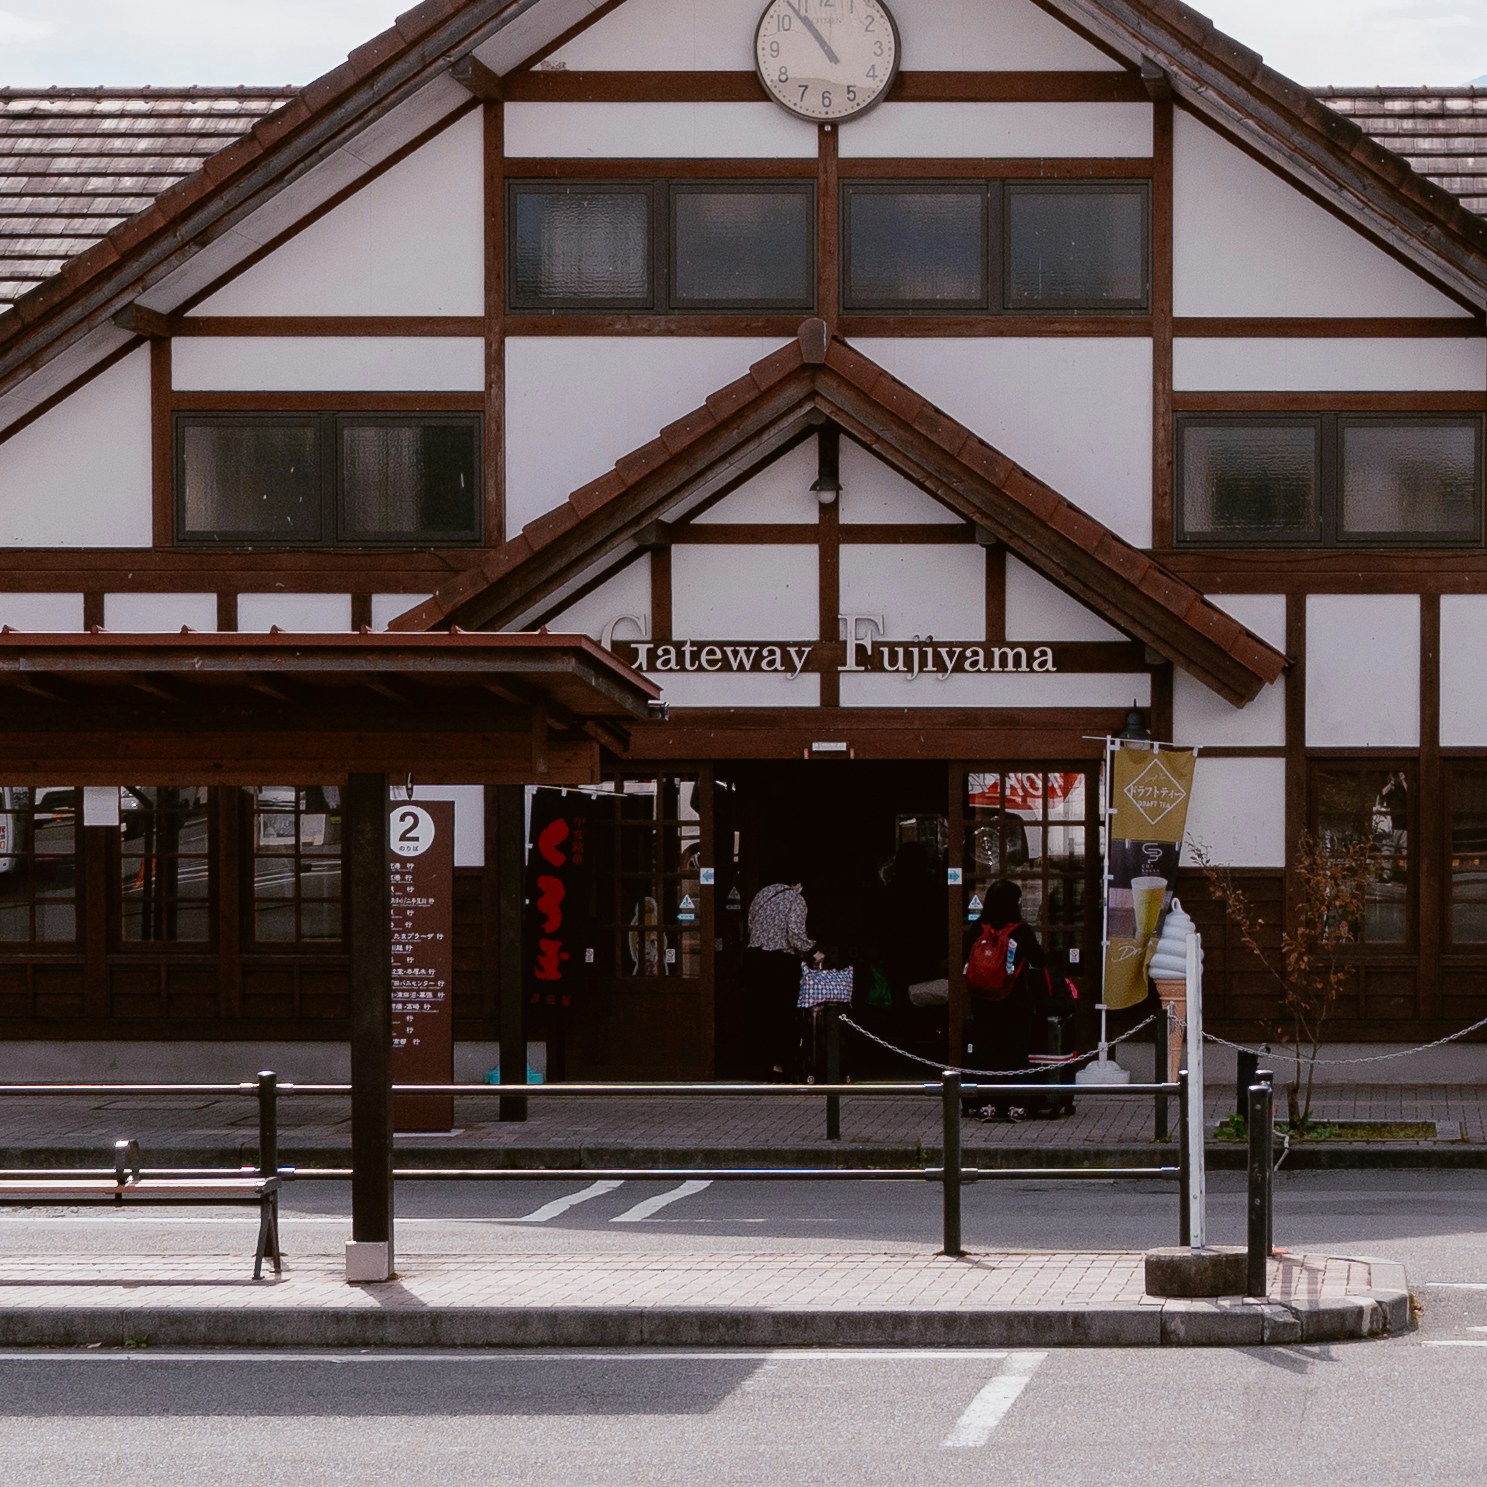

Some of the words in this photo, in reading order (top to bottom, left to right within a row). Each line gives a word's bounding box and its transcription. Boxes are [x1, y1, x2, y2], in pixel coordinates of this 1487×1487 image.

[777, 14, 792, 32] 10
[864, 15, 876, 33] 2
[769, 40, 780, 58] 9
[873, 41, 884, 57] 3
[778, 66, 789, 83] 8
[865, 64, 879, 81] 4
[798, 84, 809, 102] 7
[821, 91, 832, 108] 6
[846, 85, 857, 102] 5
[600, 613, 813, 680] Gateway
[837, 613, 1057, 680] Fujiyama
[1130, 784, 1183, 799] ドラフトティー
[398, 811, 420, 842] 2
